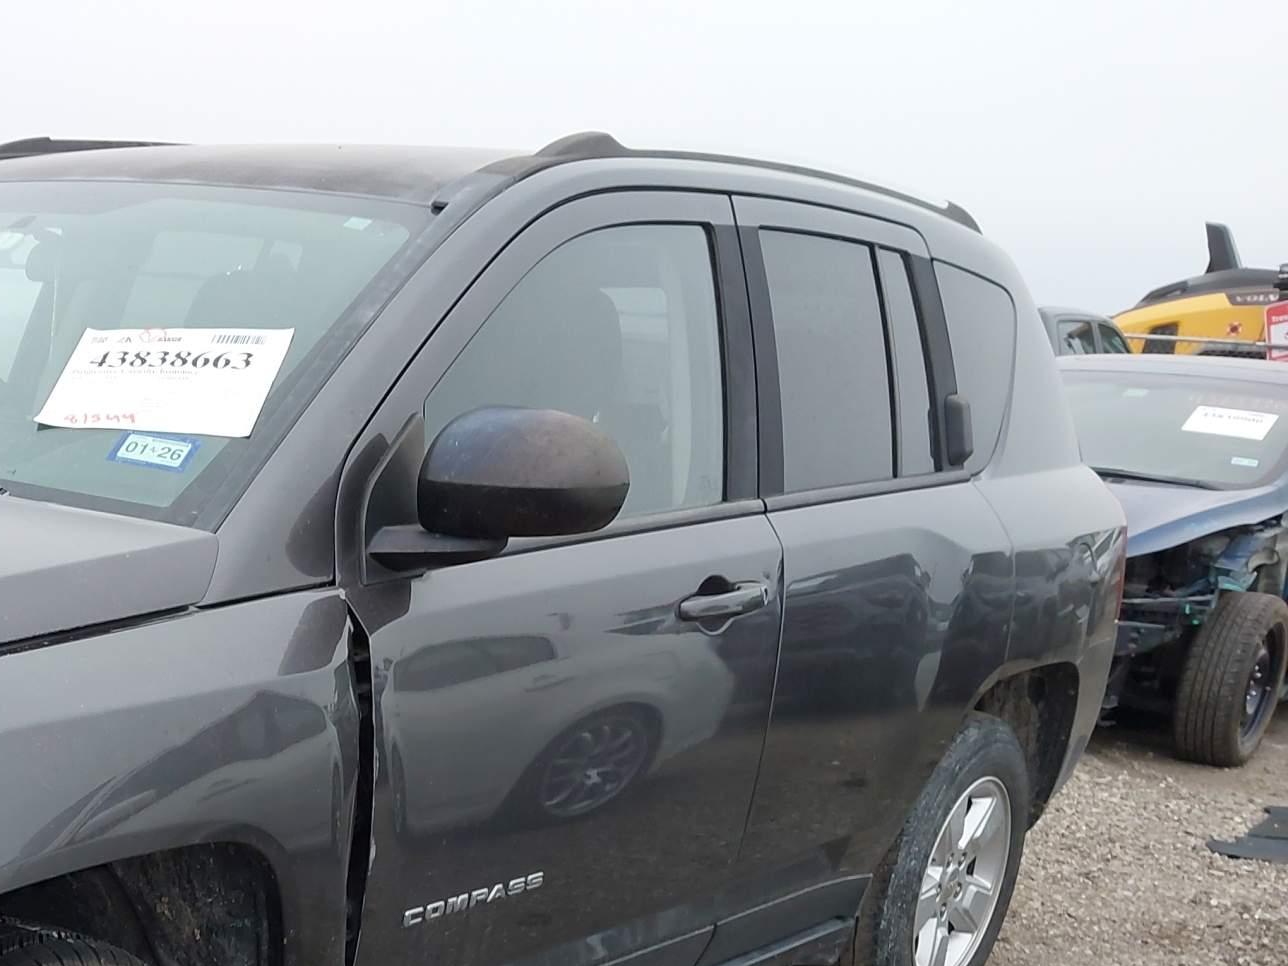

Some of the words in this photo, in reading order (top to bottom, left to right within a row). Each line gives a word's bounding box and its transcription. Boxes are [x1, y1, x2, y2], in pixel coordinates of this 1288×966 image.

[89, 350, 254, 370] 43838663
[124, 440, 149, 455] 01
[157, 446, 185, 461] 26
[402, 871, 545, 928] COMPASS
